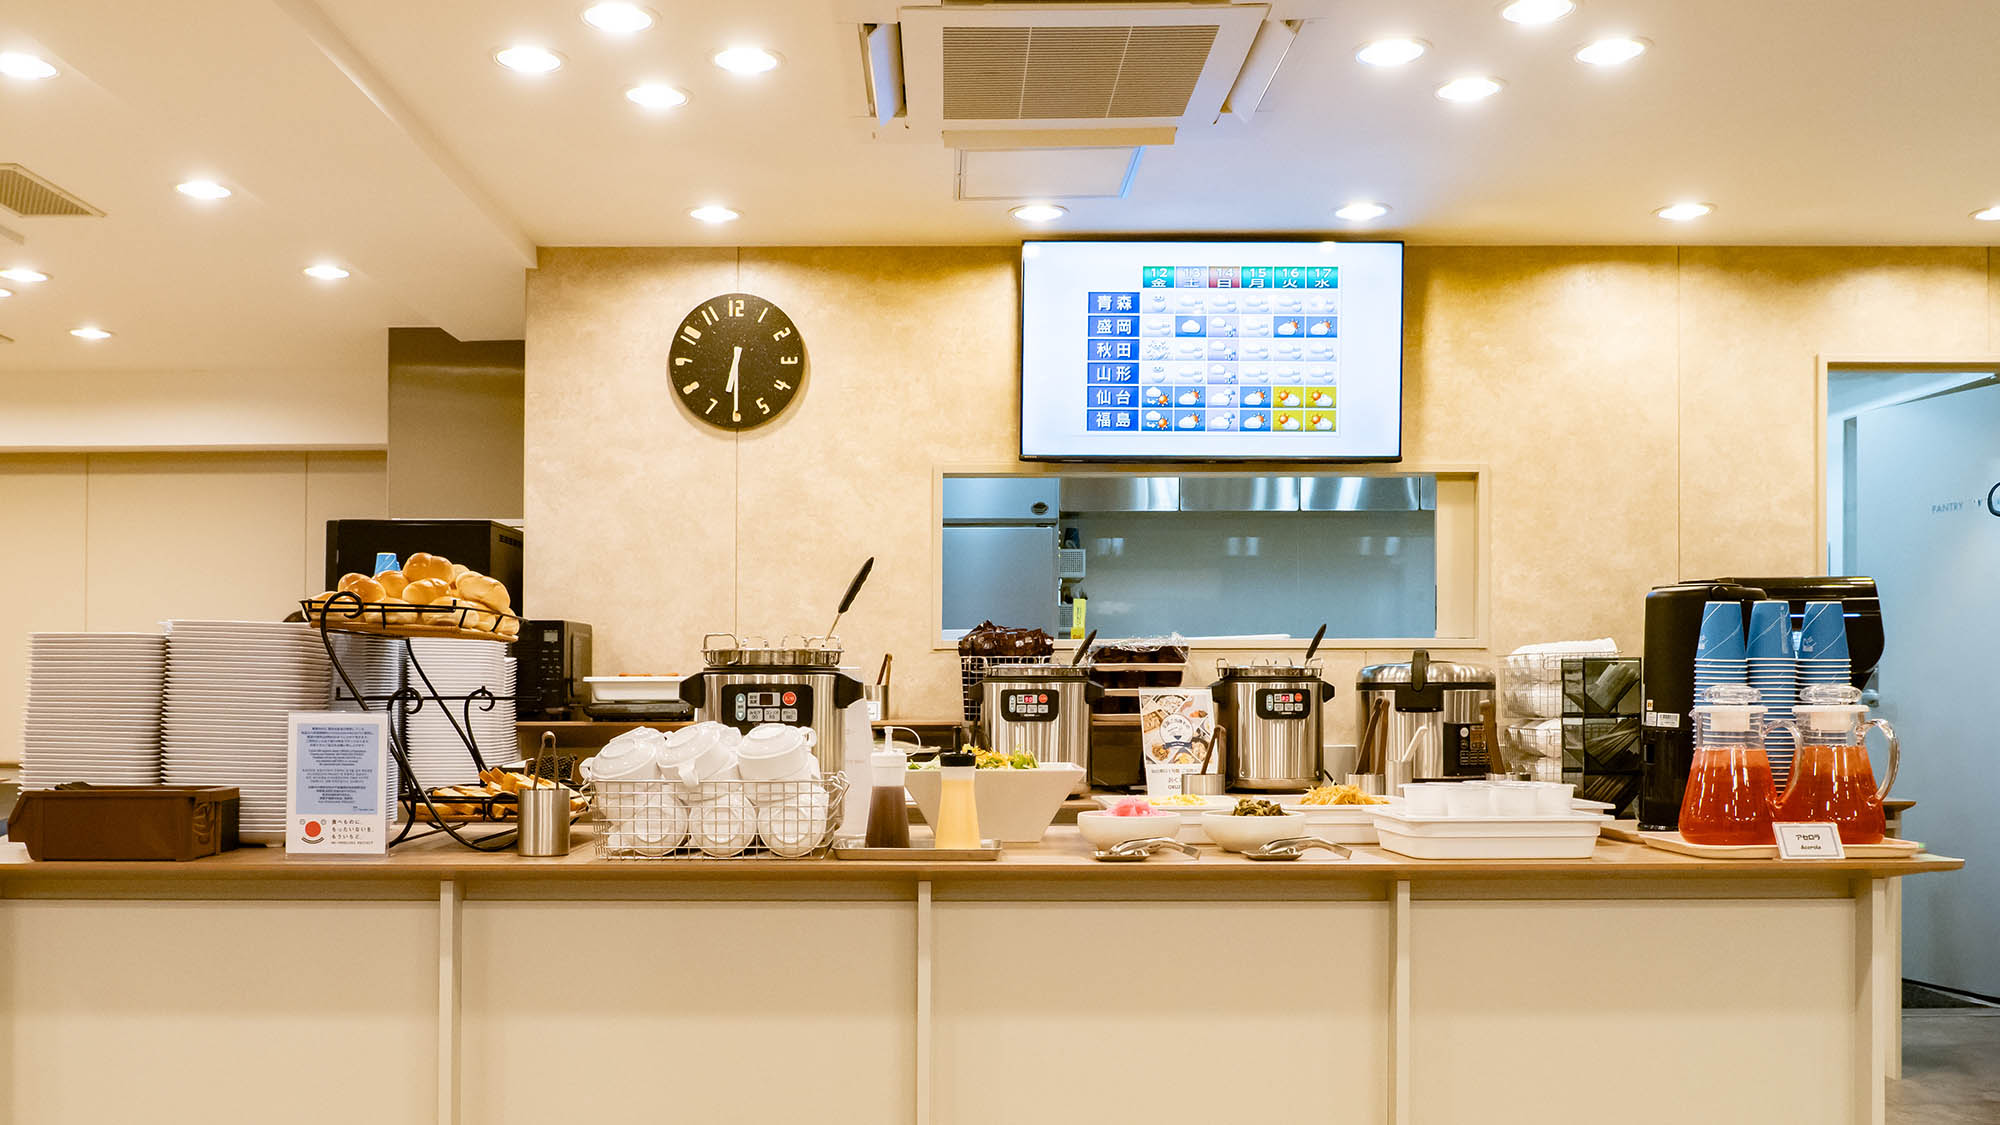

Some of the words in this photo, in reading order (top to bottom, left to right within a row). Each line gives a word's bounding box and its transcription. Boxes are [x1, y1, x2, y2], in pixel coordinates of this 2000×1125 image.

[1151, 268, 1168, 278] 12
[1183, 268, 1201, 278] 13
[1216, 268, 1234, 278] 14
[1249, 268, 1267, 278] 15
[1282, 268, 1300, 278] 16
[1314, 268, 1333, 278] 17
[1151, 279, 1167, 288] 金
[1183, 279, 1200, 288] 土
[1216, 279, 1232, 288] 日
[1249, 279, 1264, 288] 月
[1282, 279, 1298, 288] 火
[1314, 279, 1330, 288] 水
[728, 299, 745, 317] 12
[1097, 295, 1132, 311] 青森
[701, 305, 720, 326] 11
[757, 307, 768, 323] 1
[680, 325, 702, 345] 10
[773, 327, 791, 342] 2
[1096, 319, 1132, 335] 盛岡
[1096, 342, 1131, 358] 秋田
[675, 357, 693, 366] 9
[780, 356, 798, 365] 3
[1096, 365, 1132, 382] 山形
[682, 381, 700, 395] 8
[774, 379, 791, 391] 4
[1096, 389, 1131, 405] 仙台
[705, 398, 719, 415] 7
[755, 397, 771, 415] 5
[732, 409, 741, 422] 6
[1096, 412, 1131, 428] 福島
[1931, 502, 1963, 514] PANTRY
